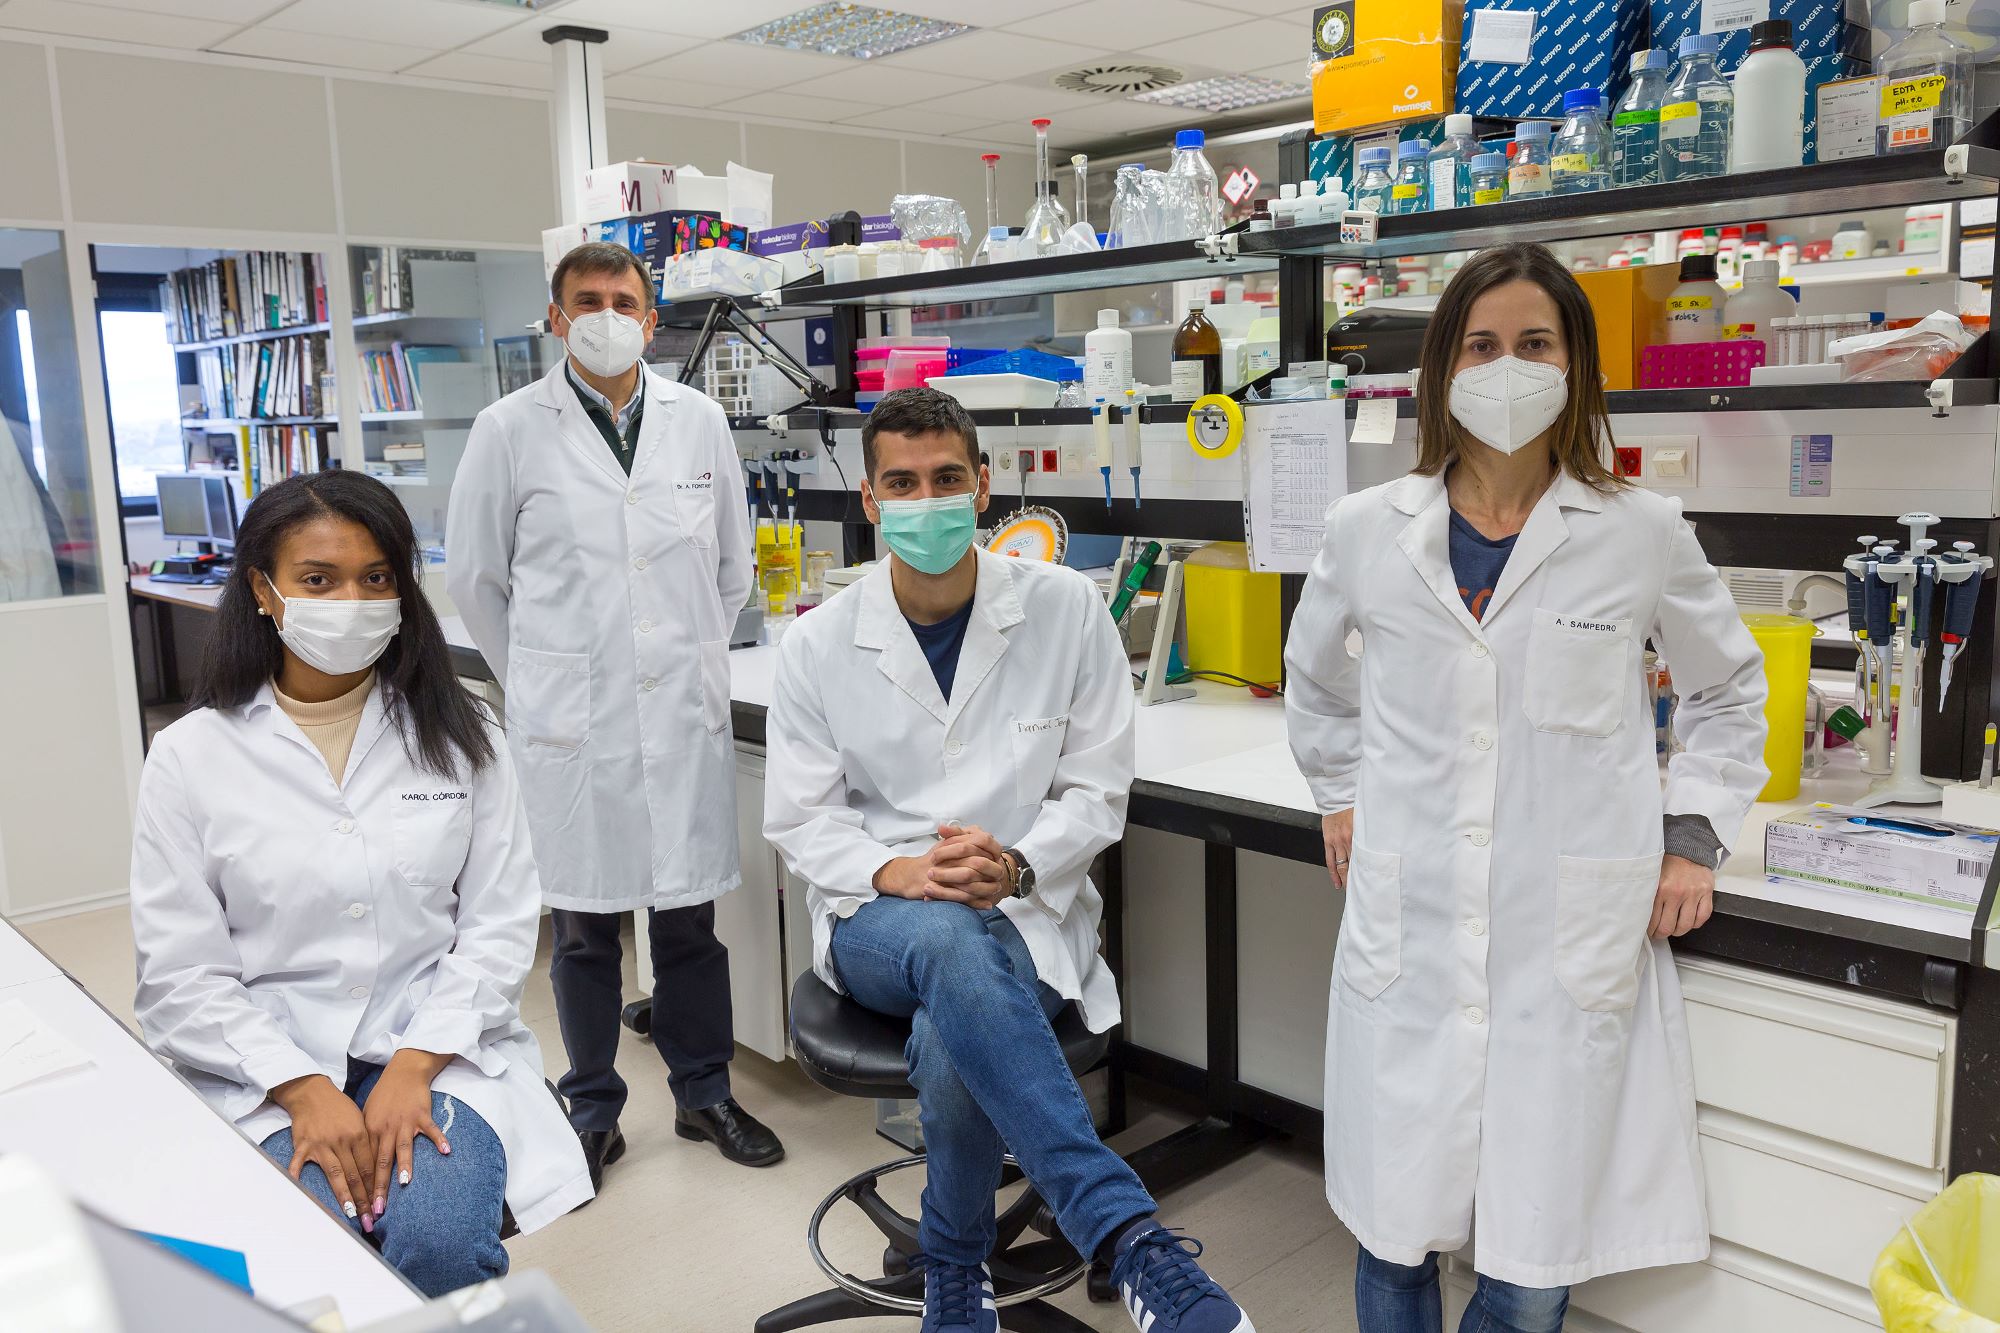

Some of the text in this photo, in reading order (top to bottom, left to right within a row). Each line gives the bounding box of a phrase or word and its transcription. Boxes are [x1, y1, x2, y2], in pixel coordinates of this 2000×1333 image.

[1541, 0, 1562, 17] QIAGE
[1582, 1, 1605, 24] QIAGEN
[1798, 4, 1824, 31] QIAGEN
[1555, 13, 1577, 36] QIAGEN
[1596, 20, 1619, 44] QIAGEN
[1653, 11, 1674, 38] QIAGEN
[1568, 32, 1591, 55] QIAGEN
[1540, 44, 1562, 66] QIAGEN
[1582, 51, 1606, 74] QIAGEN
[1487, 66, 1508, 87] QIAGEN
[1554, 62, 1576, 85] QIAGEN
[1665, 60, 1680, 78] AGEN
[1463, 77, 1483, 97] QIAGEN
[1501, 84, 1522, 106] QIAGEN
[1527, 73, 1549, 95] QIAGEN
[1893, 84, 1916, 96] EDTA
[1392, 101, 1432, 114] Promega
[1476, 95, 1496, 116] QIAGEN
[1541, 92, 1563, 114] QIAGEN
[1323, 144, 1338, 165] QIAGEN
[662, 168, 675, 185] M
[621, 180, 642, 212] M
[1555, 618, 1617, 632] A. SAMPEDRO
[401, 793, 430, 801] KAROL
